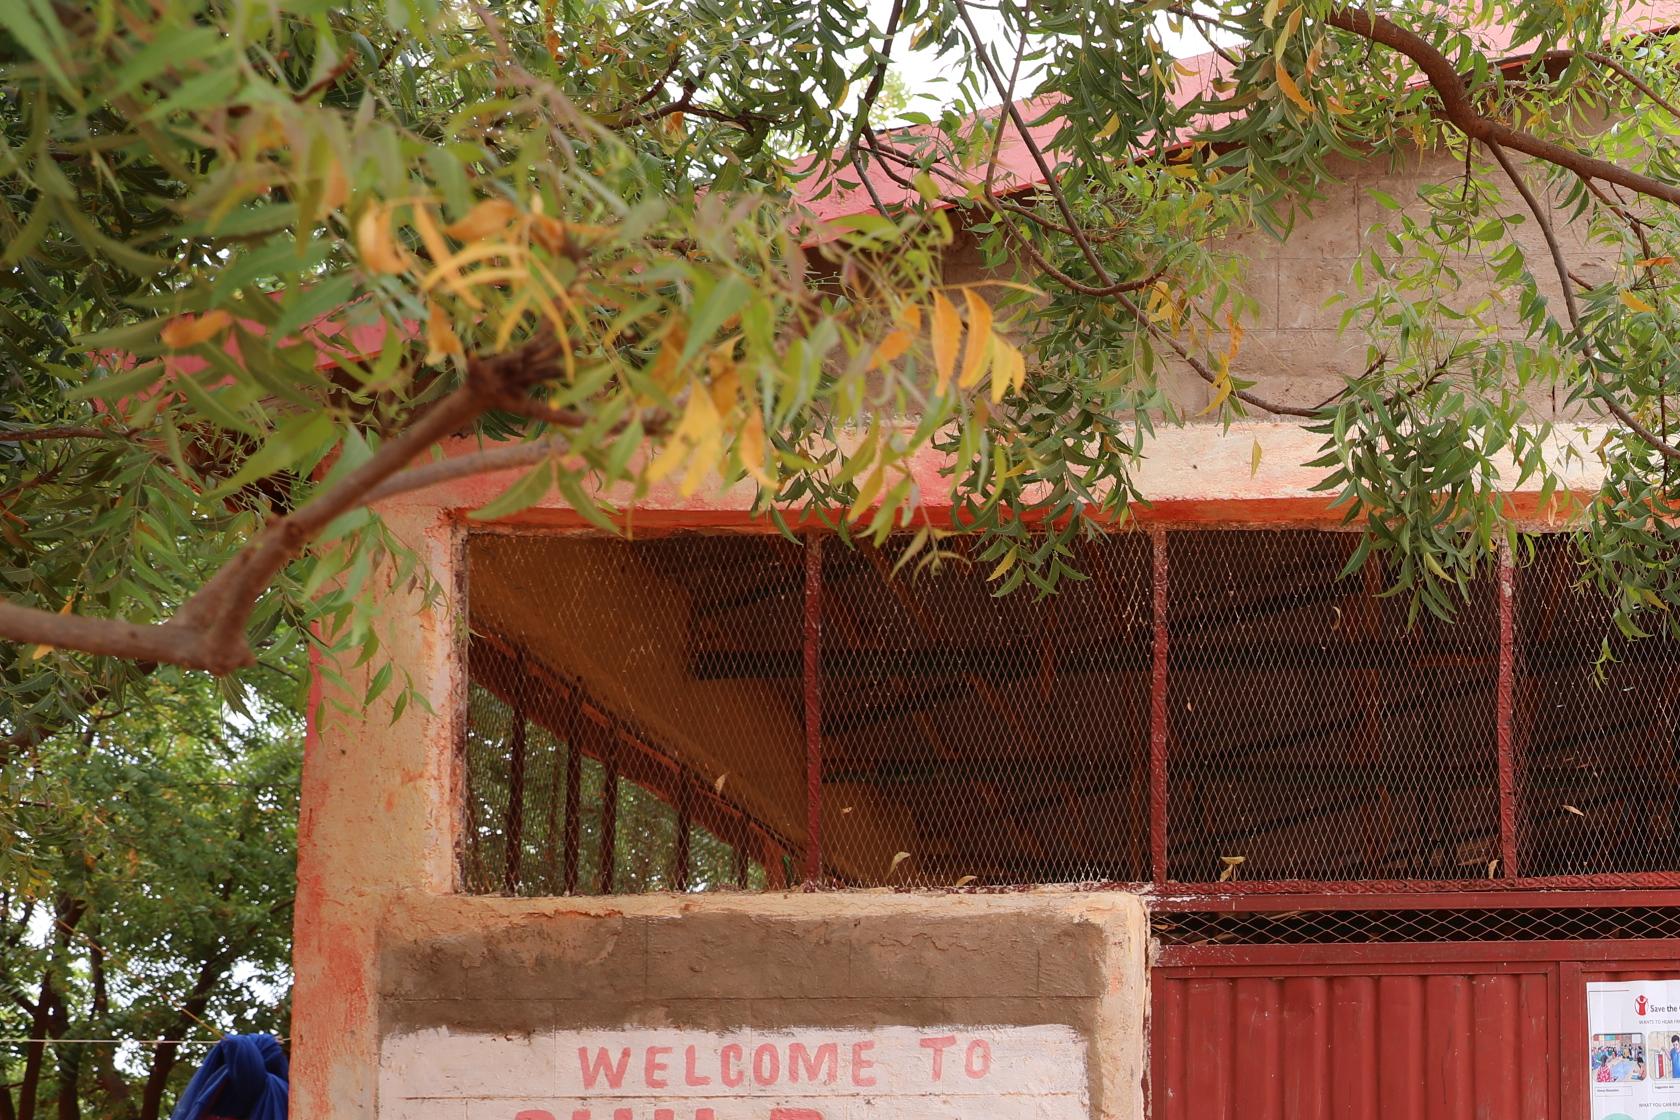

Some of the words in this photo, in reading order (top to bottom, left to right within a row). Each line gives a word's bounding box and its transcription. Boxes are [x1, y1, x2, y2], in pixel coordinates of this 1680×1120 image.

[1650, 1004, 1665, 1013] Save
[1666, 1004, 1678, 1012] the
[578, 1040, 878, 1090] WELCOME
[919, 1035, 993, 1081] TO
